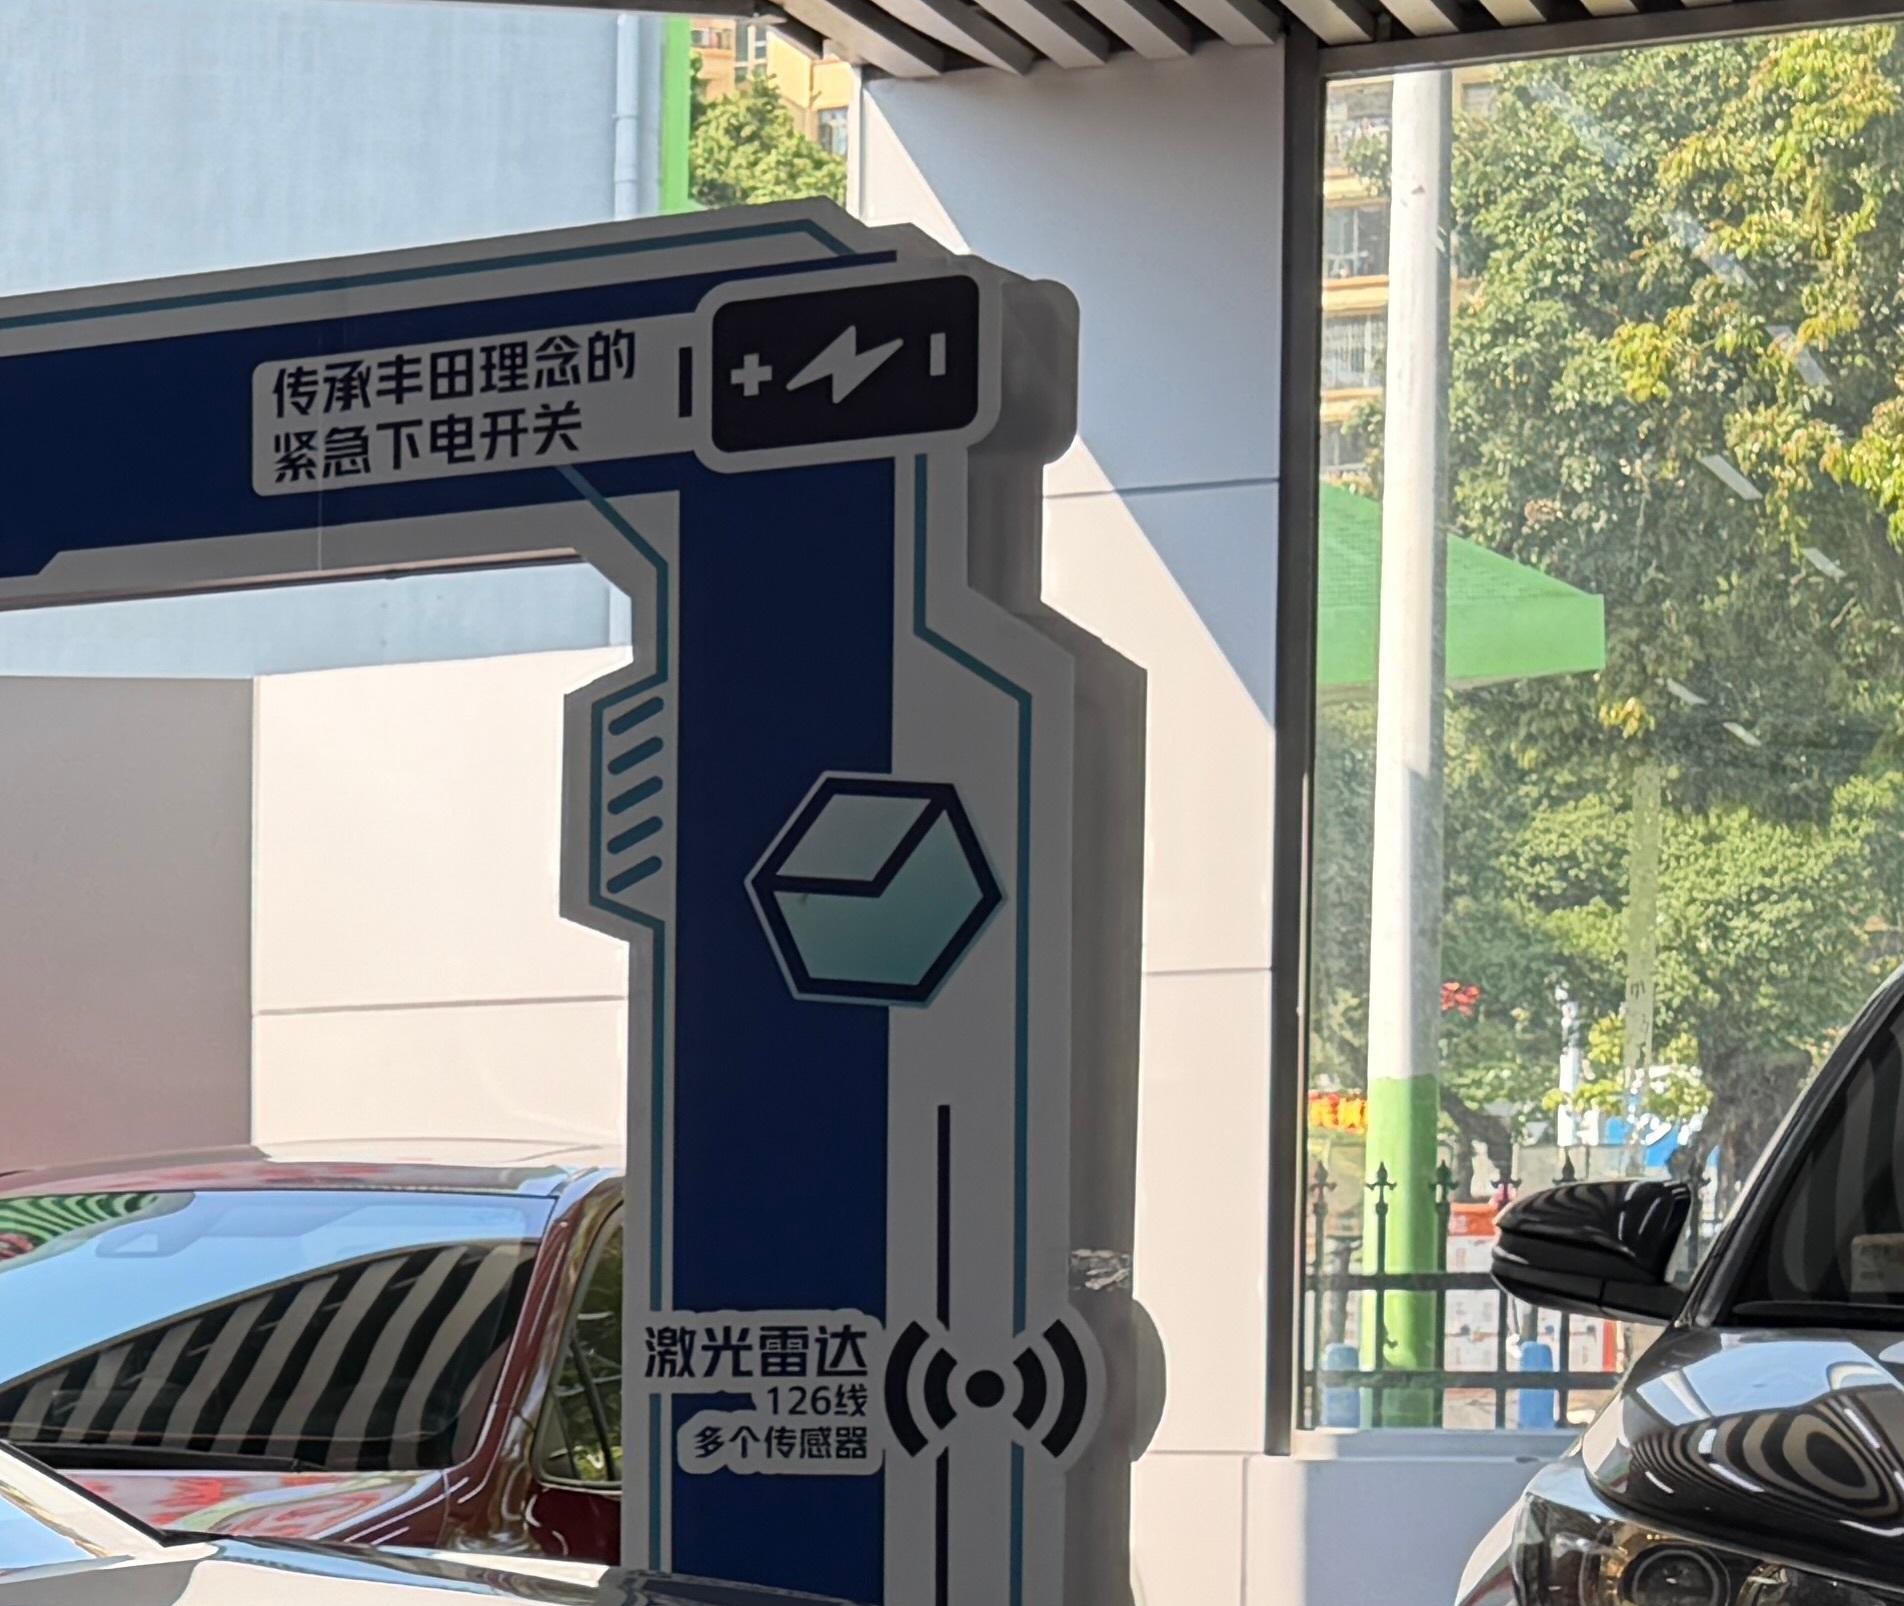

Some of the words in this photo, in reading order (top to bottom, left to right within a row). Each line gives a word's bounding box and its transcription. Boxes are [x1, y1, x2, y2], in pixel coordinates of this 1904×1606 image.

[272, 329, 636, 418] 传承丰田理念的
[272, 400, 583, 484] 紧急下电开关
[644, 1324, 869, 1378] 激光雷达
[767, 1383, 868, 1417] 126线
[694, 1425, 868, 1459] 多个传感器
